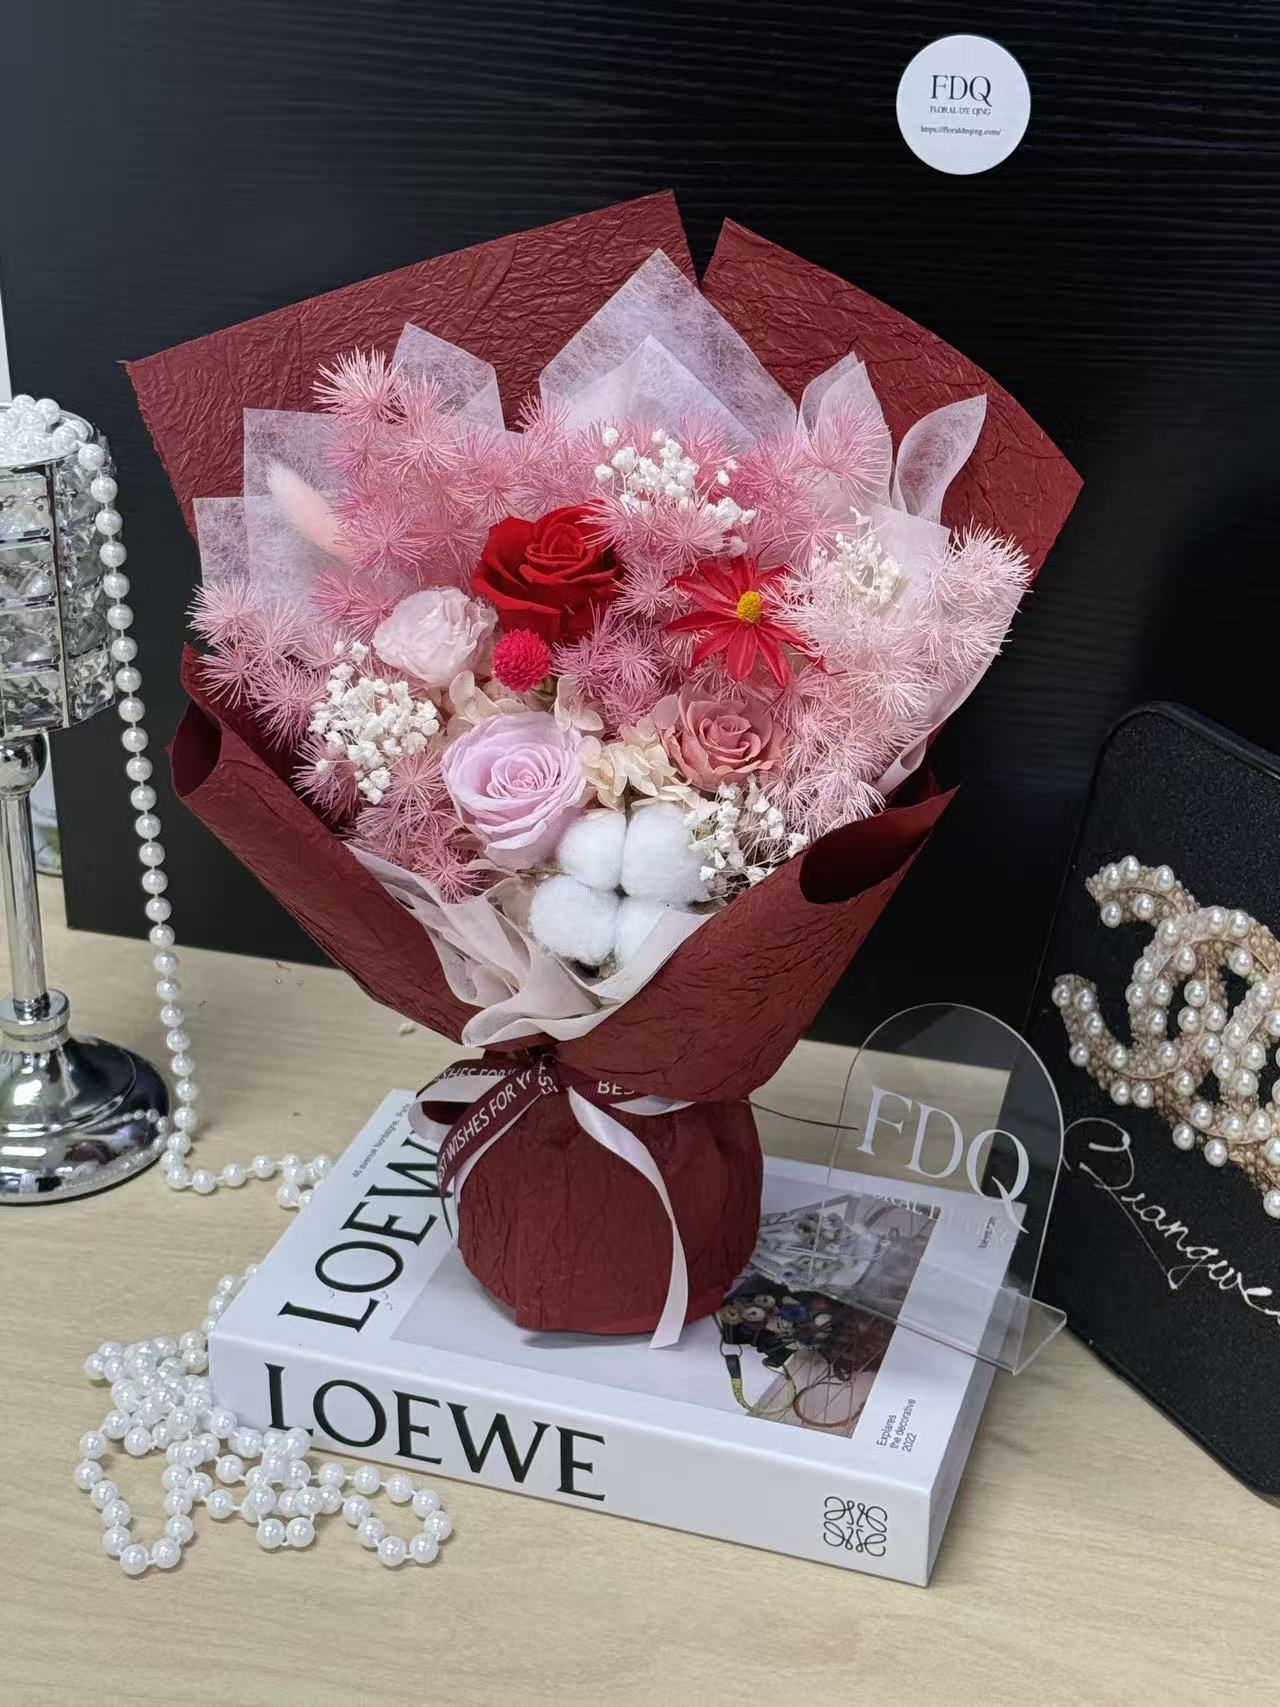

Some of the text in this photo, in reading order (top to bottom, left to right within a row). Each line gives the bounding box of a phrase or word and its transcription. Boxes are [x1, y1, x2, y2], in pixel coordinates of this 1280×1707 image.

[929, 105, 991, 117] FLORAL DYE QING
[930, 75, 993, 108] FDQ
[445, 1107, 490, 1161] WISHES
[488, 1083, 518, 1118] FOR
[857, 1086, 1030, 1234] FDQ
[277, 1130, 455, 1333] LOEW
[264, 1361, 607, 1502] LOEWE
[889, 1398, 917, 1449] the decorative
[901, 1432, 918, 1452] 2022
